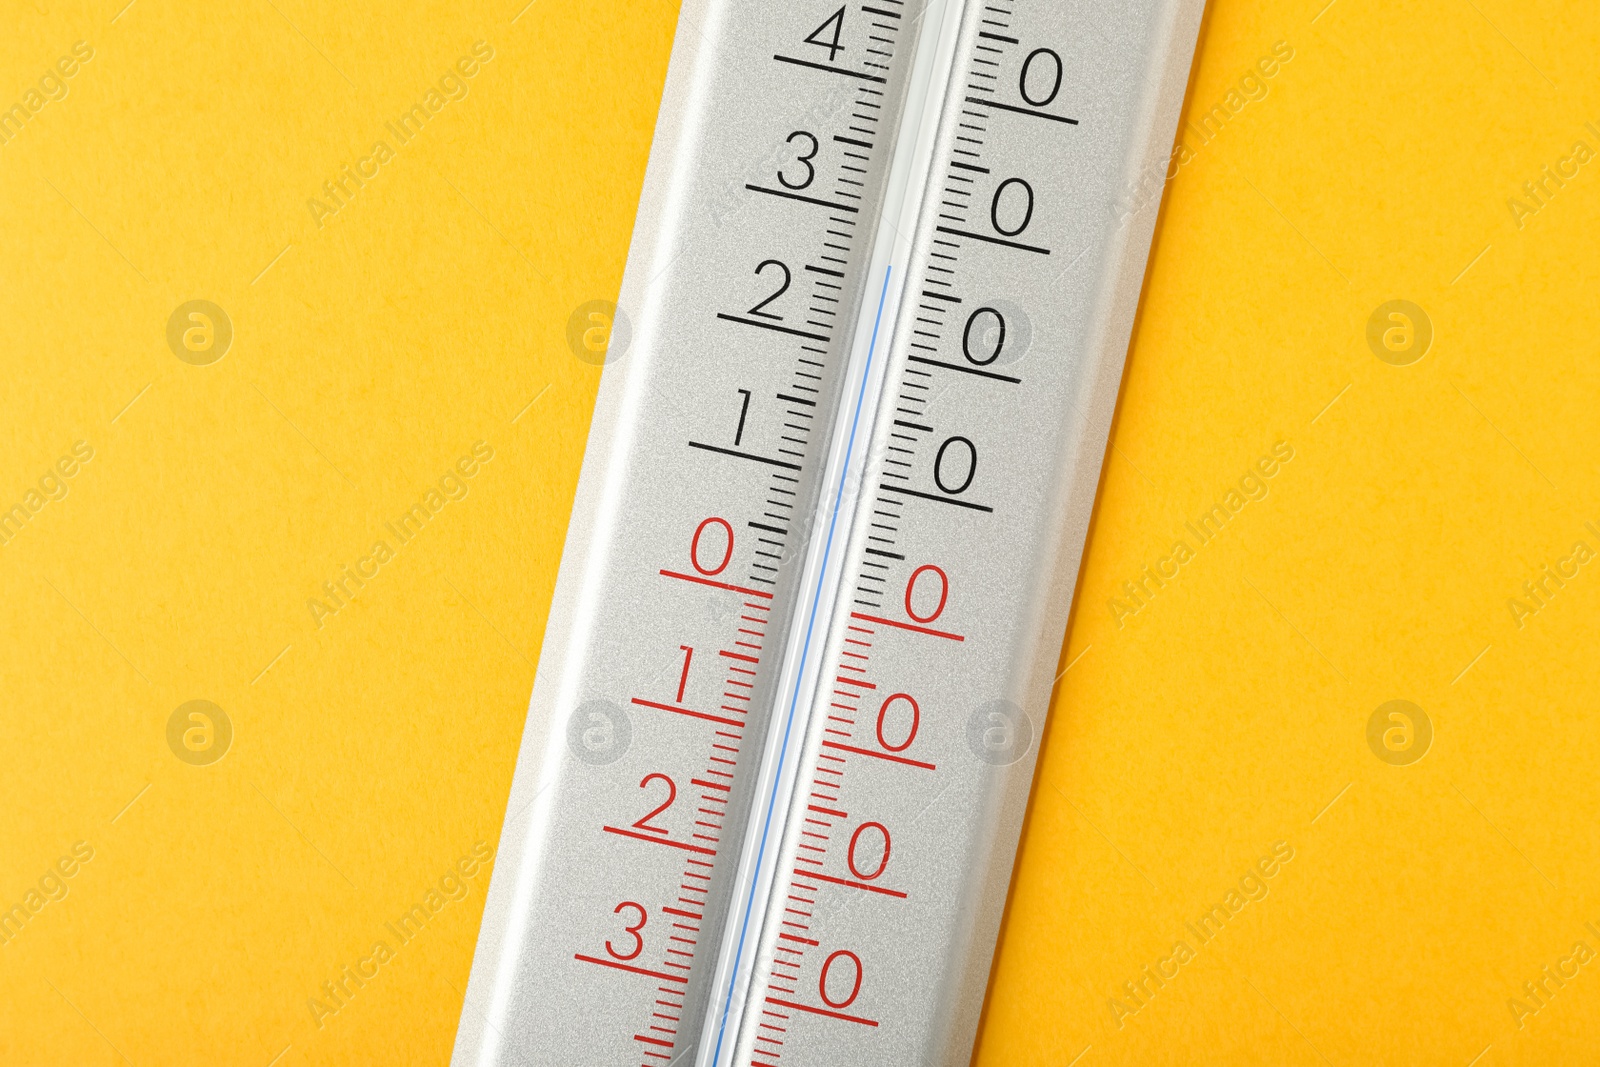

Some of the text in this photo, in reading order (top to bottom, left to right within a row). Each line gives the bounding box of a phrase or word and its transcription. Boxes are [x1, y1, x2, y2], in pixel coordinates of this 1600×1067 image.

[803, 4, 1063, 107] 4 0
[777, 130, 819, 191] 3
[990, 177, 1034, 237] 0
[746, 259, 1006, 367] 2 0
[734, 388, 752, 446] 1
[933, 435, 978, 495] 0
[690, 517, 949, 624] 0 0
[676, 645, 920, 752] 1 0
[632, 773, 891, 881] 2 0
[605, 901, 648, 961] 3
[819, 949, 863, 1009] 0
